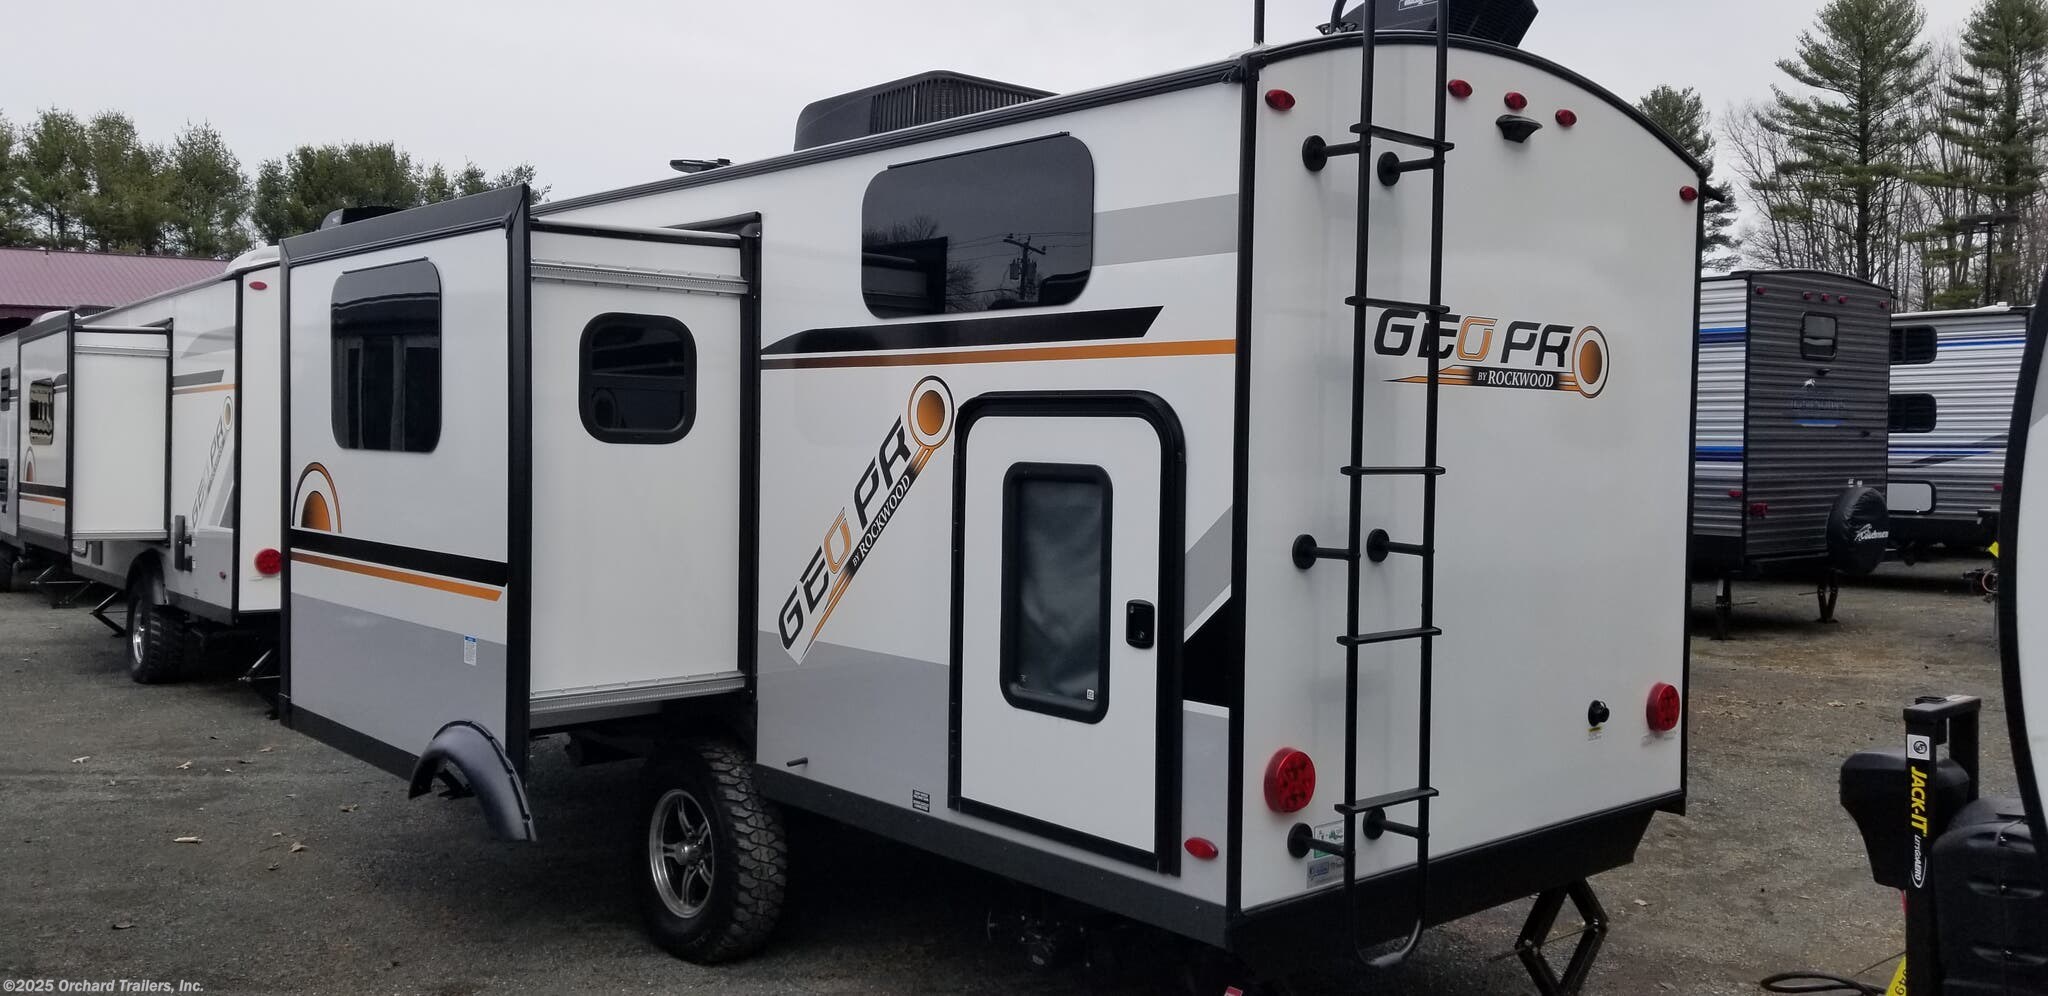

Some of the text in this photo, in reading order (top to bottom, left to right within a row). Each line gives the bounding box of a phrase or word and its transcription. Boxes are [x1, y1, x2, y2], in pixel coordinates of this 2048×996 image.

[1374, 308, 1498, 362] GEO
[1477, 370, 1554, 388] BY ROCKWOOD
[852, 474, 911, 567] BY ROCKWOOD
[778, 506, 852, 650] GEO
[1911, 766, 1928, 837] JACK-IT
